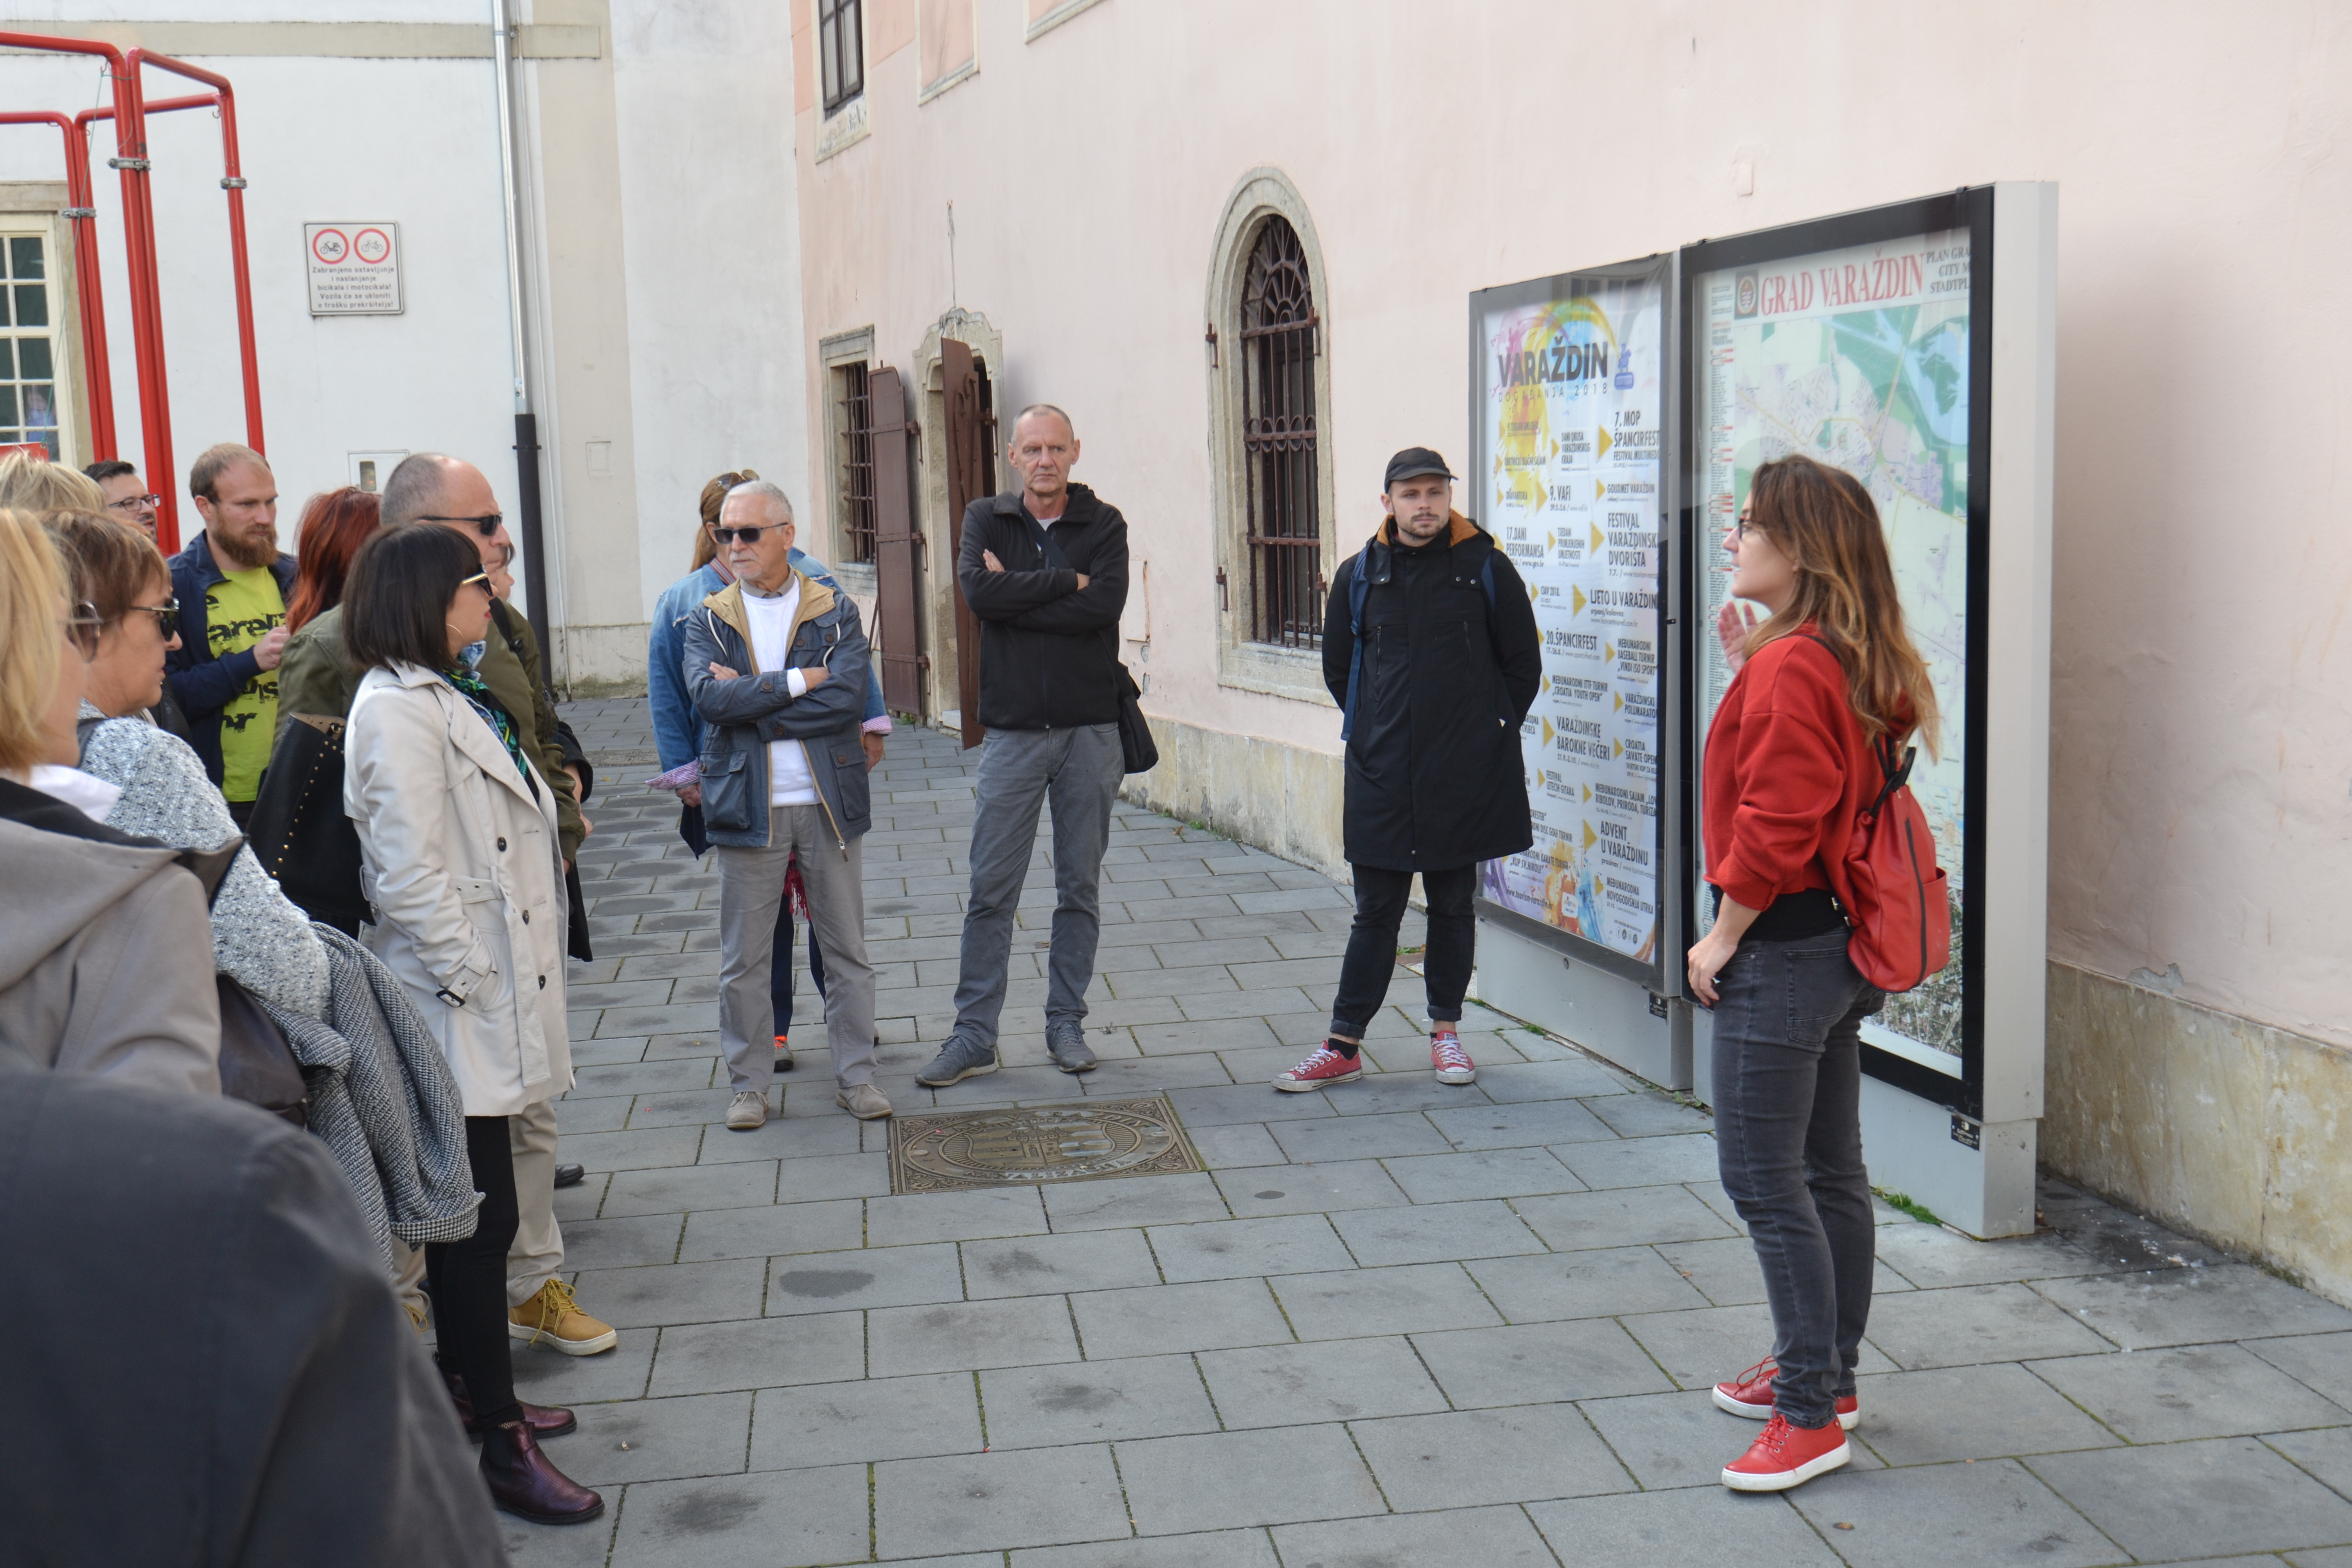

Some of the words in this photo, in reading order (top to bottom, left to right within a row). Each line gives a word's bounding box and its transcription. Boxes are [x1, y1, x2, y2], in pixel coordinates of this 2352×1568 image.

[1926, 249, 1949, 264] PLAN
[1939, 263, 1960, 277] CITY
[1761, 272, 1814, 316] GRAD
[1819, 248, 1924, 307] VARAŽDIN
[1498, 335, 1608, 388] VARAŽDIN
[1498, 386, 1564, 403] DOGAĐANJA
[1574, 383, 1608, 397] 2018
[1614, 412, 1622, 427] 7.
[1623, 410, 1640, 427] MOP
[1614, 428, 1659, 448] ŠPANCIRFEST
[1550, 486, 1556, 501] 9.
[1557, 485, 1571, 501] VAFI
[1608, 512, 1639, 528] FESTIVAL
[1506, 543, 1544, 558] PERFORMANSA
[1590, 589, 1609, 605] LJETO
[1612, 591, 1617, 606] U
[1546, 627, 1597, 651] 20.ŠPANCIRFEST
[1618, 638, 1651, 651] MEĐUNARODNI
[1618, 650, 1637, 662] BASEBALL
[1639, 652, 1654, 664] TURNIR
[1574, 689, 1588, 700] YOUTH
[1557, 716, 1601, 738] VARAŽDINSKE
[1557, 736, 1586, 755] BAROKNE
[1588, 740, 1610, 761] VEČERI
[1625, 739, 1645, 751] CROATIA
[1625, 750, 1643, 763] SAVATE
[1546, 770, 1562, 782] FESTIVAL
[1560, 785, 1575, 797] GITARA
[1596, 783, 1628, 799] MEĐUNARODNI
[1596, 794, 1616, 809] RIBOLOV,
[1617, 799, 1639, 815] PRIRODA,
[1601, 821, 1627, 841] ADVENT
[1541, 852, 1554, 866] KARATE
[1601, 839, 1606, 853] U
[1607, 842, 1649, 866] VARAŽDINU
[1601, 859, 1619, 868] prosinac
[1606, 876, 1639, 896] MEĐUNARODNA
[1606, 890, 1639, 910] NOVOGODIŠNJA
[1640, 901, 1654, 915] UTRKA
